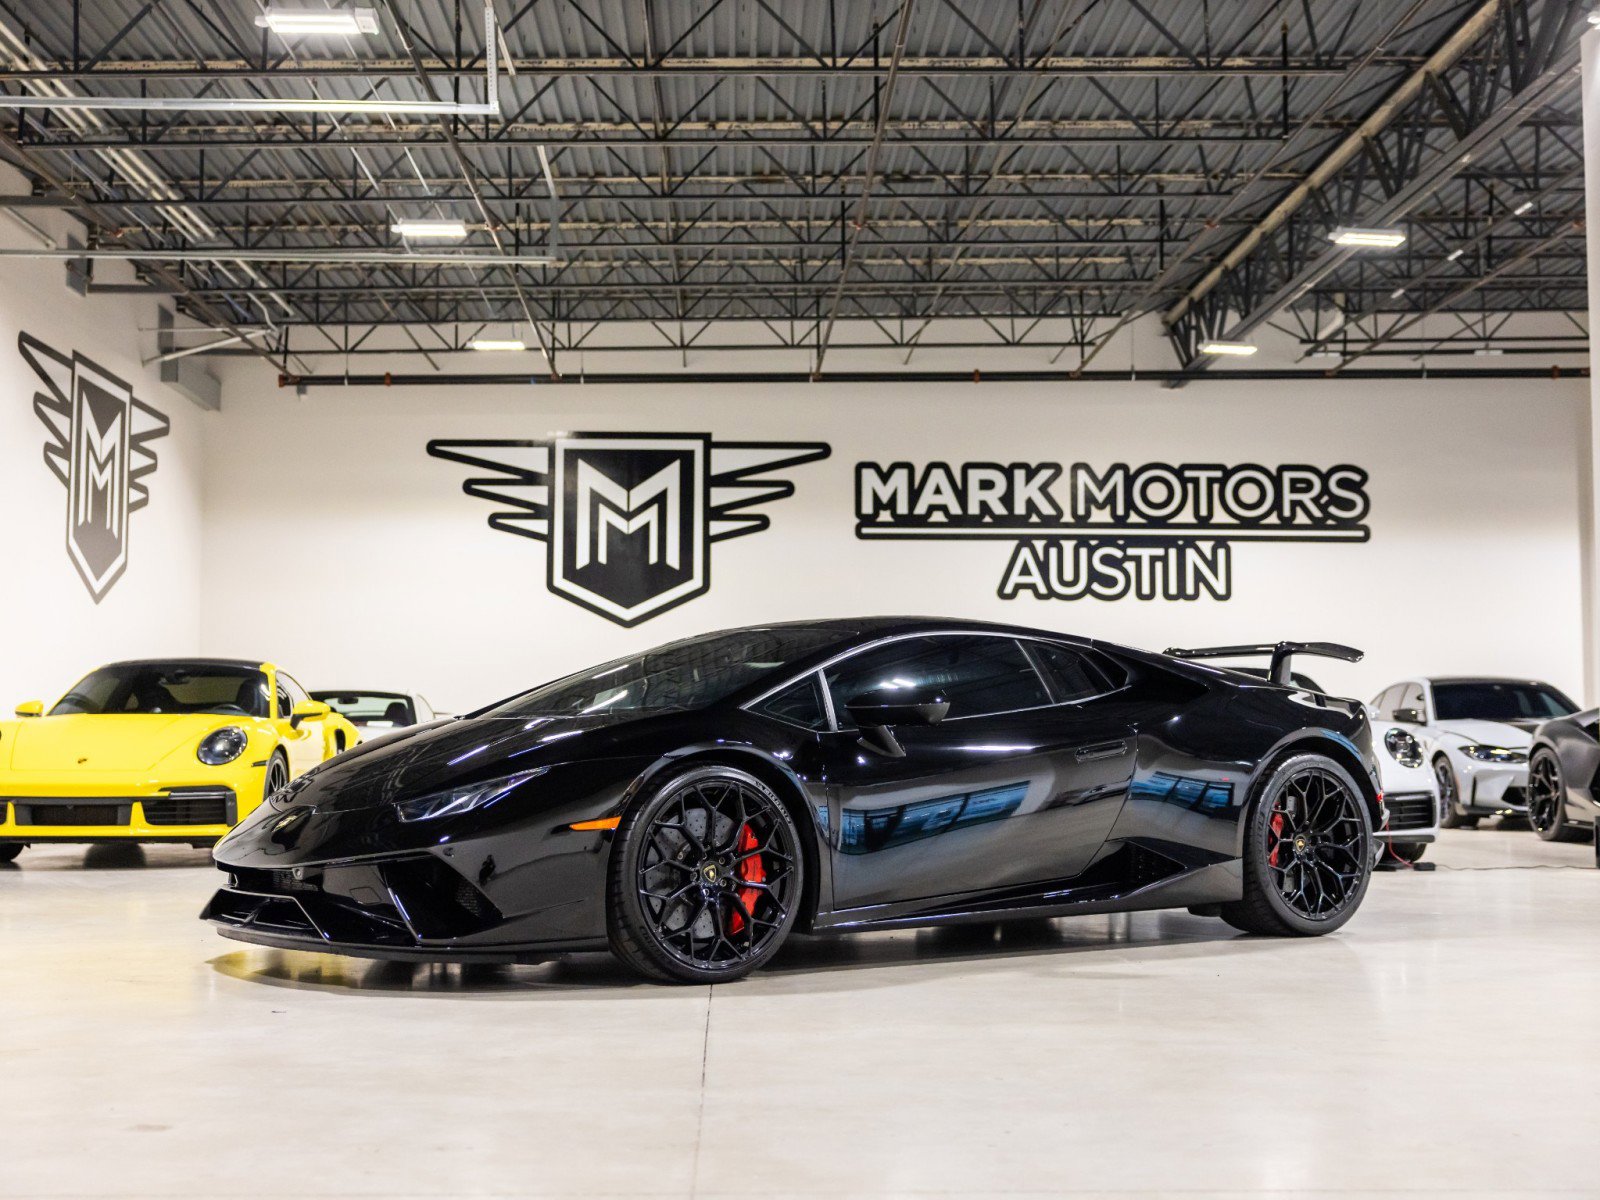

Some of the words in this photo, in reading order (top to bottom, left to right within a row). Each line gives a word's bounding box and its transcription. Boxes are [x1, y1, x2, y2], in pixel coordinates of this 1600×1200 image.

[858, 464, 1060, 518] MARK
[1073, 466, 1368, 521] MOTORS
[1000, 543, 1230, 598] AUSTIN
